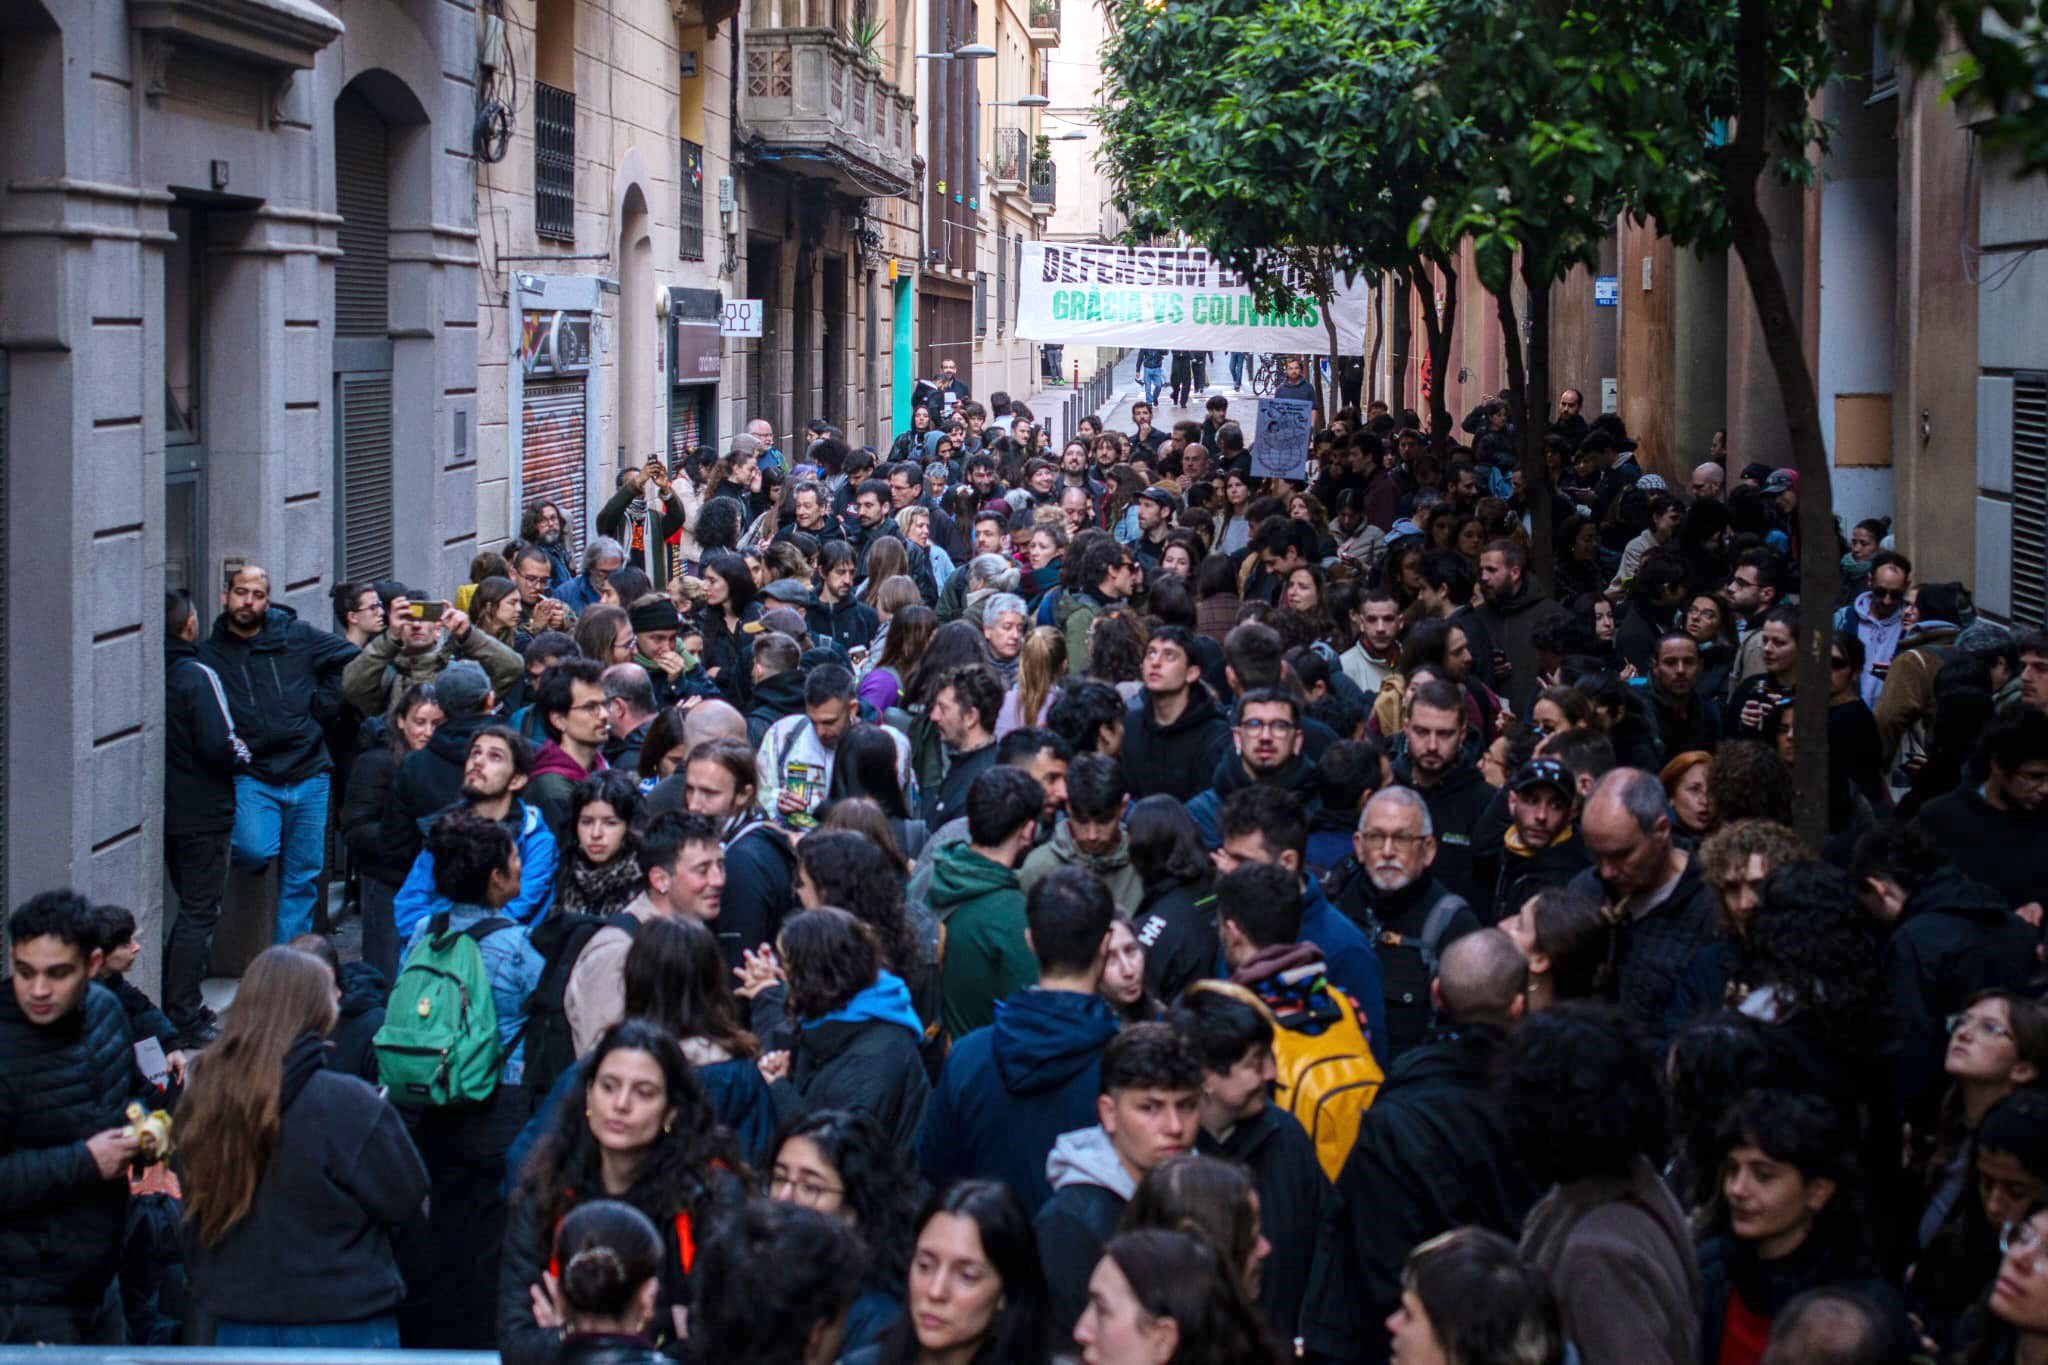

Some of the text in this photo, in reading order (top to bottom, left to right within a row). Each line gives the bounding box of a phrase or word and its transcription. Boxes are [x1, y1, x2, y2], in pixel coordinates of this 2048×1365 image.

[1042, 246, 1206, 288] DEFENSEM
[1052, 285, 1143, 323] GRÀCIA
[1152, 293, 1184, 324] VS
